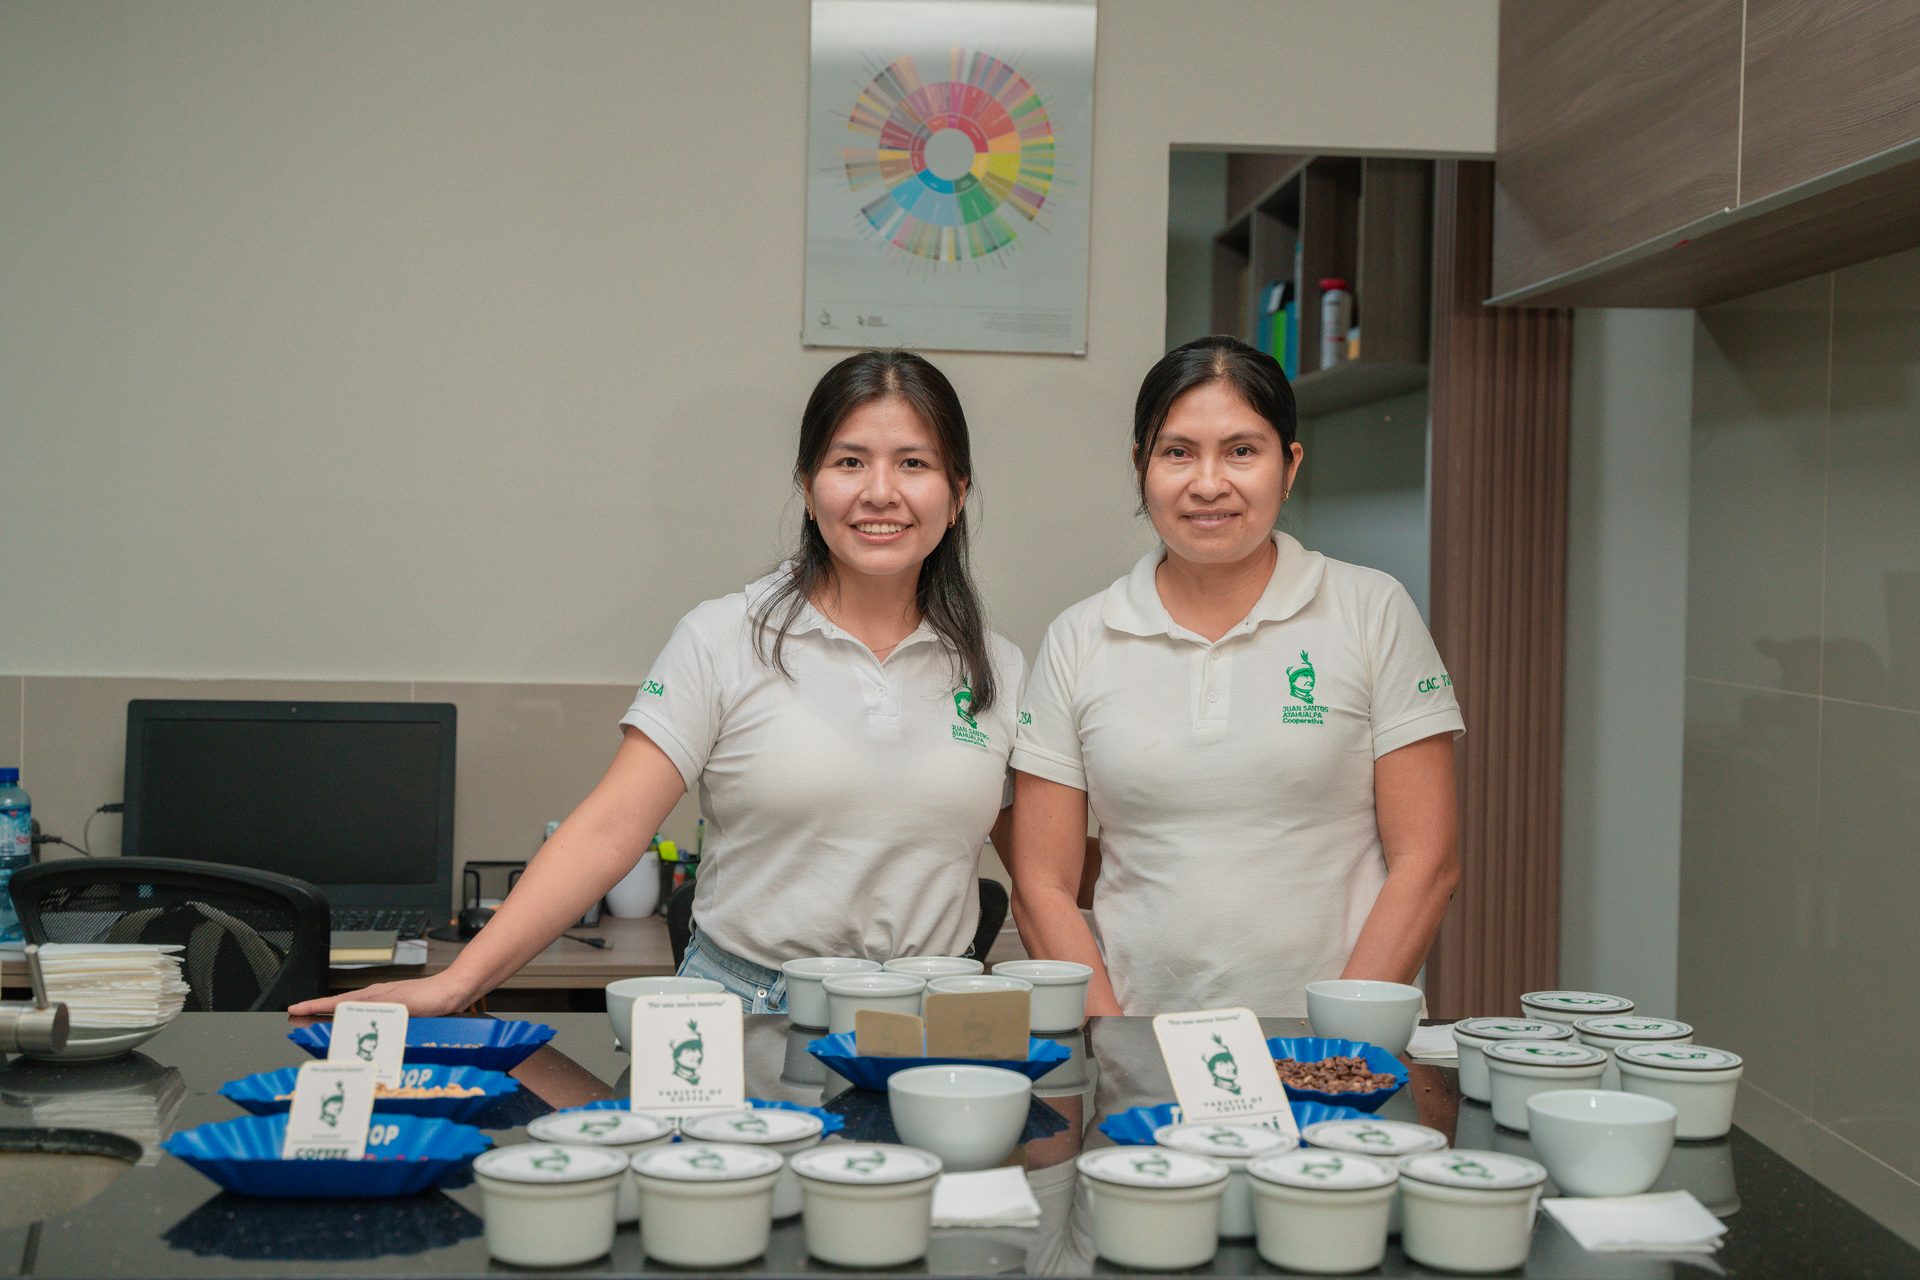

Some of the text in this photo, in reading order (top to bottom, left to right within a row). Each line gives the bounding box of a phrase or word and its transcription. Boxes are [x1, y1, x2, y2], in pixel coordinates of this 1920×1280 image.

[1418, 676, 1440, 693] CAC
[1303, 705, 1329, 713] SANTOS
[1282, 711, 1323, 719] ATAHUALPA
[1282, 717, 1324, 725] Cooperativa
[658, 1088, 722, 1097] VARIETY OF
[670, 1095, 710, 1103] COFFEE
[1203, 1095, 1263, 1108] VARIETY OF
[1216, 1103, 1254, 1113] COFFEE
